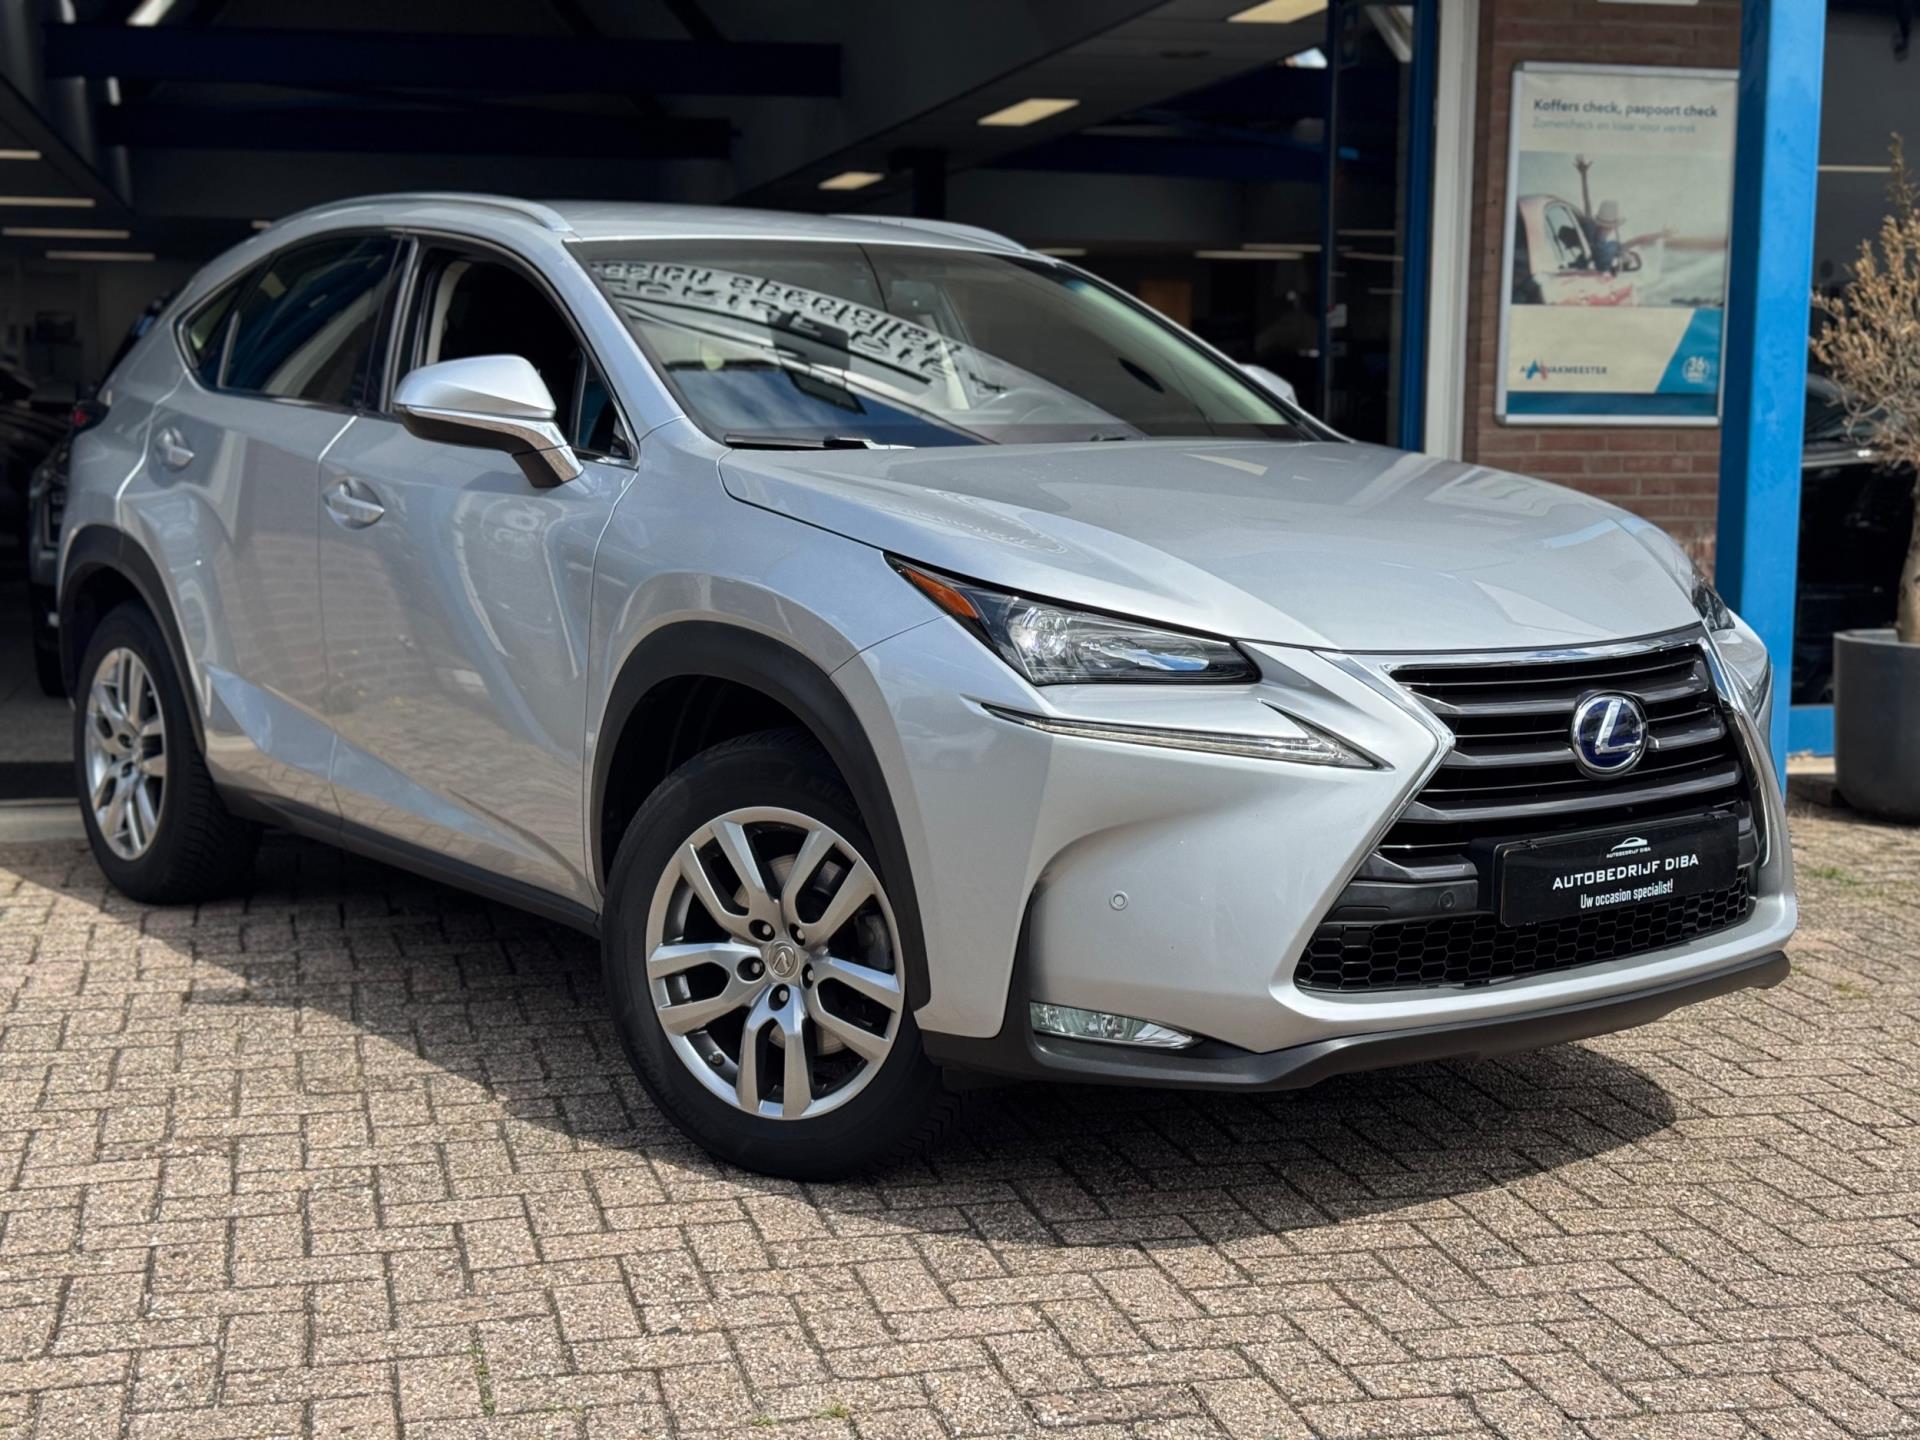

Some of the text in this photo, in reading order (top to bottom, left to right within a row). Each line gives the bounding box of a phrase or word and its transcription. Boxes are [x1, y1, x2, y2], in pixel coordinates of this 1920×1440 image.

[1533, 99, 1718, 118] Koffers check, paspoort check
[1552, 854, 1699, 891] AUTOBEDRIJF DIBA
[1580, 878, 1674, 909] Uw occasion specialist!
